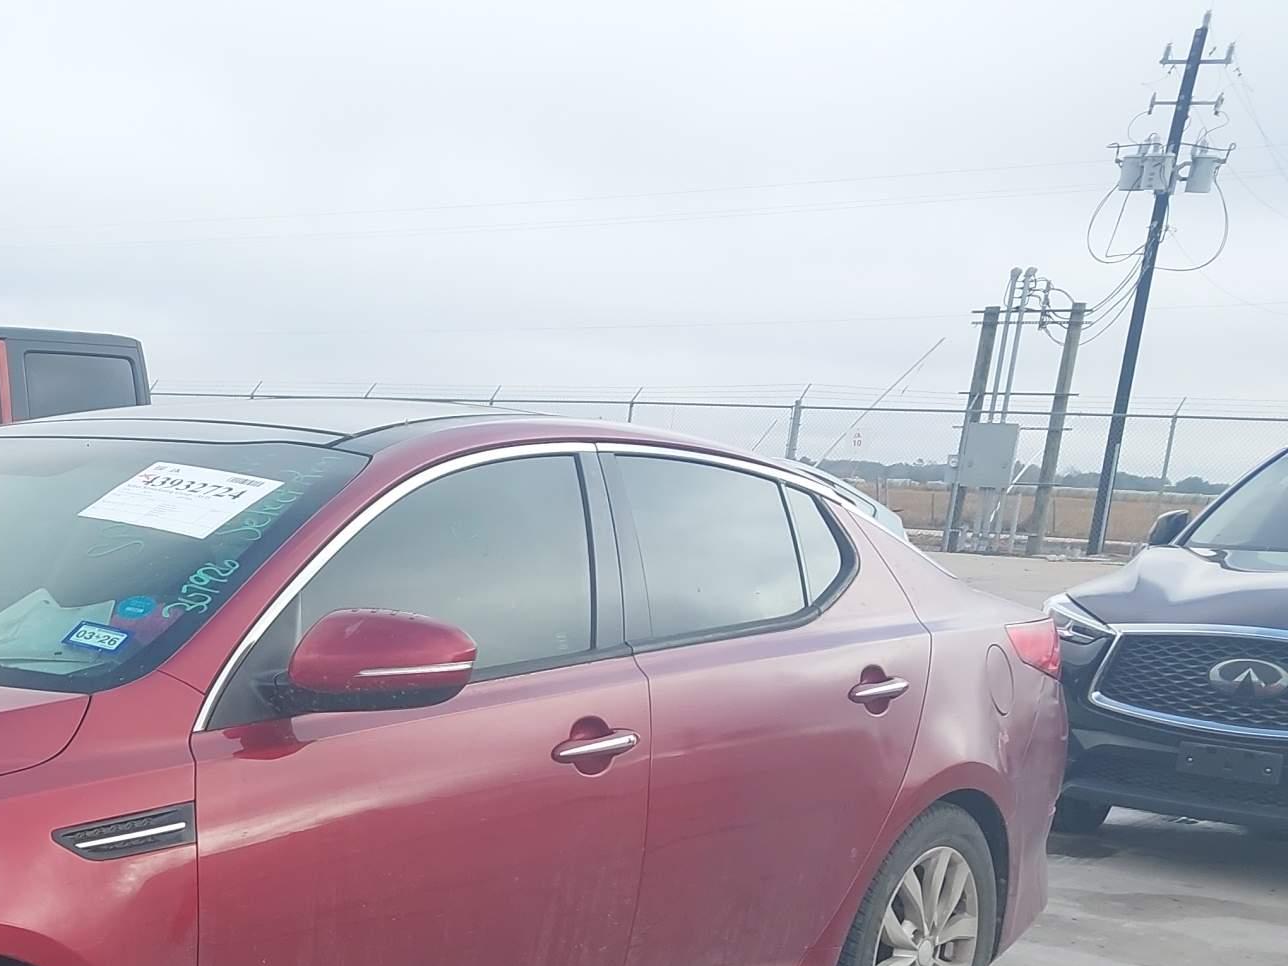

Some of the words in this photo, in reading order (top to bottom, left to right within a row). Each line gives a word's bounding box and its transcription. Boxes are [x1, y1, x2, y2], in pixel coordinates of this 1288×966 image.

[142, 474, 248, 501] 43932724
[75, 630, 96, 641] 03
[98, 634, 120, 647] 26
